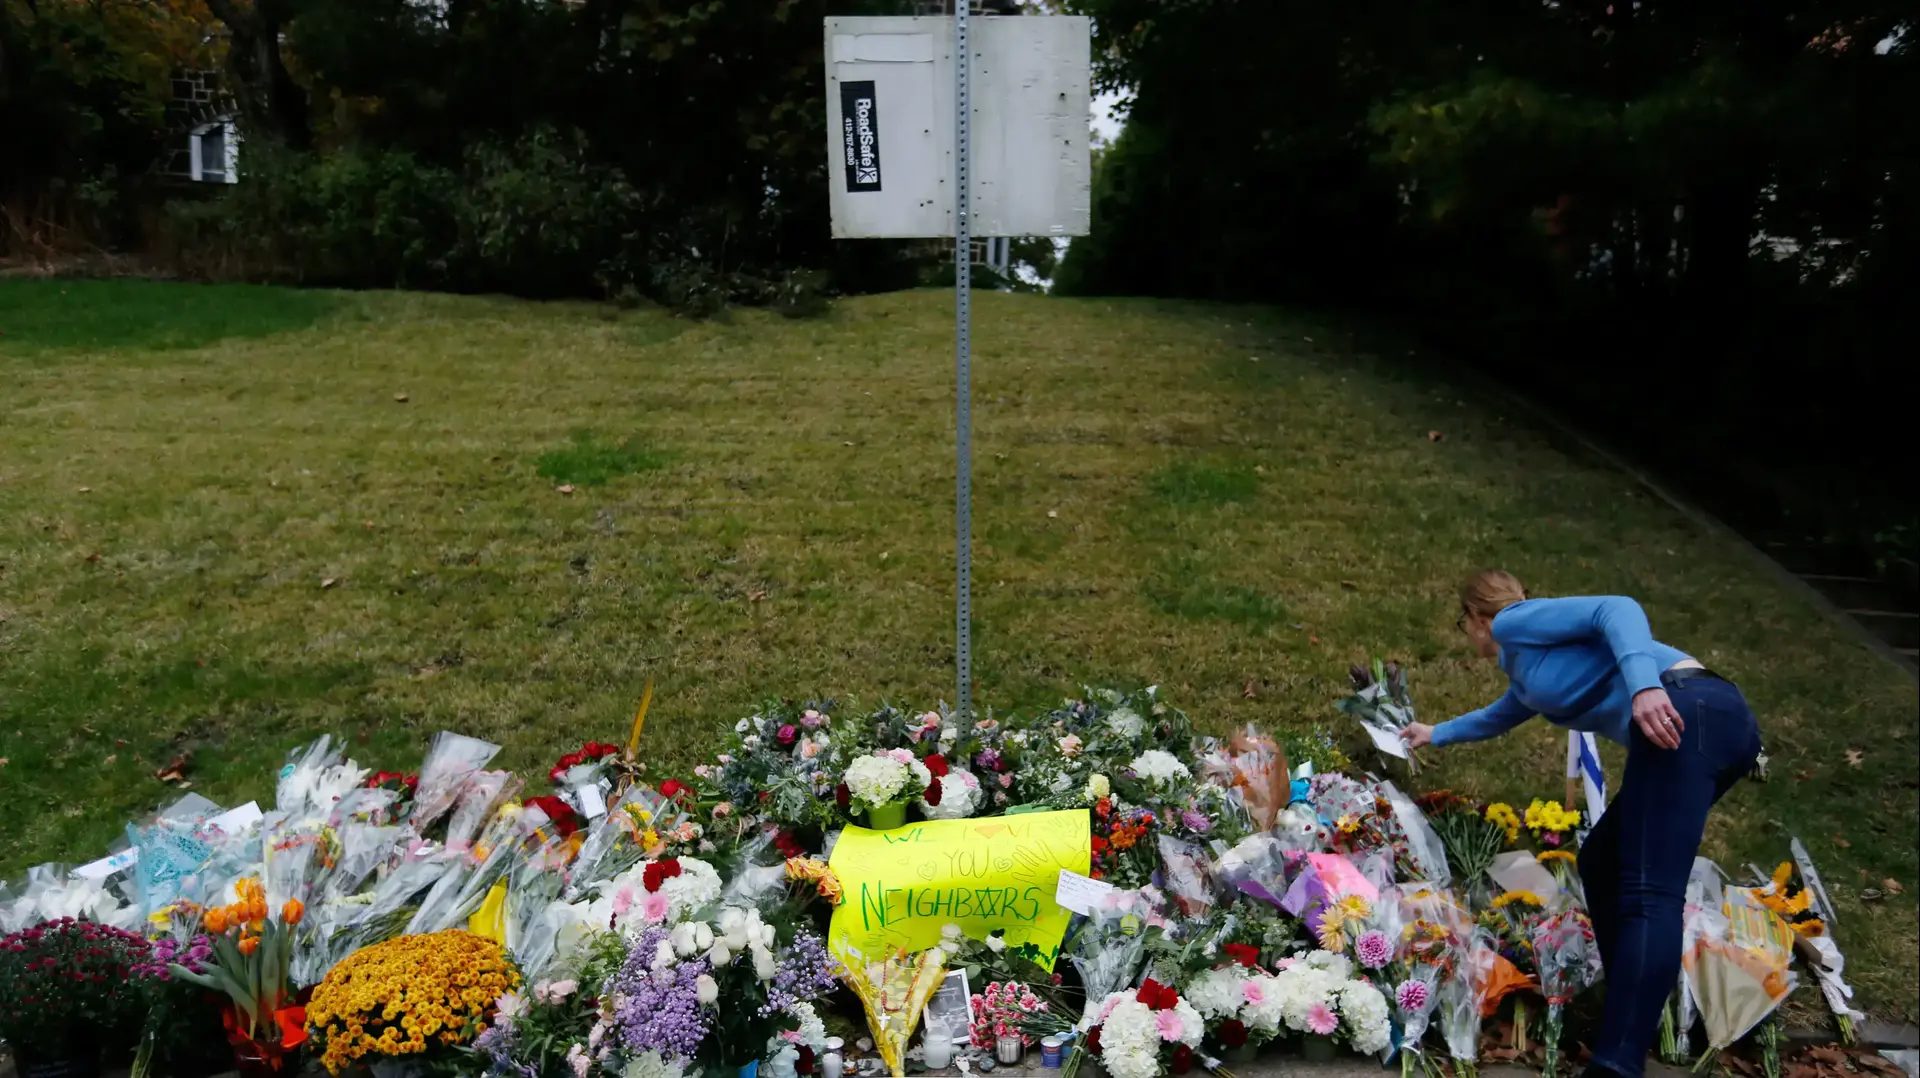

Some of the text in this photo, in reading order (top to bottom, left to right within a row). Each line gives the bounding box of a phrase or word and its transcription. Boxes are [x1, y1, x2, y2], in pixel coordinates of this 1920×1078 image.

[858, 99, 875, 166] RoadSafe
[884, 827, 935, 844] WE
[943, 846, 990, 879] YOU
